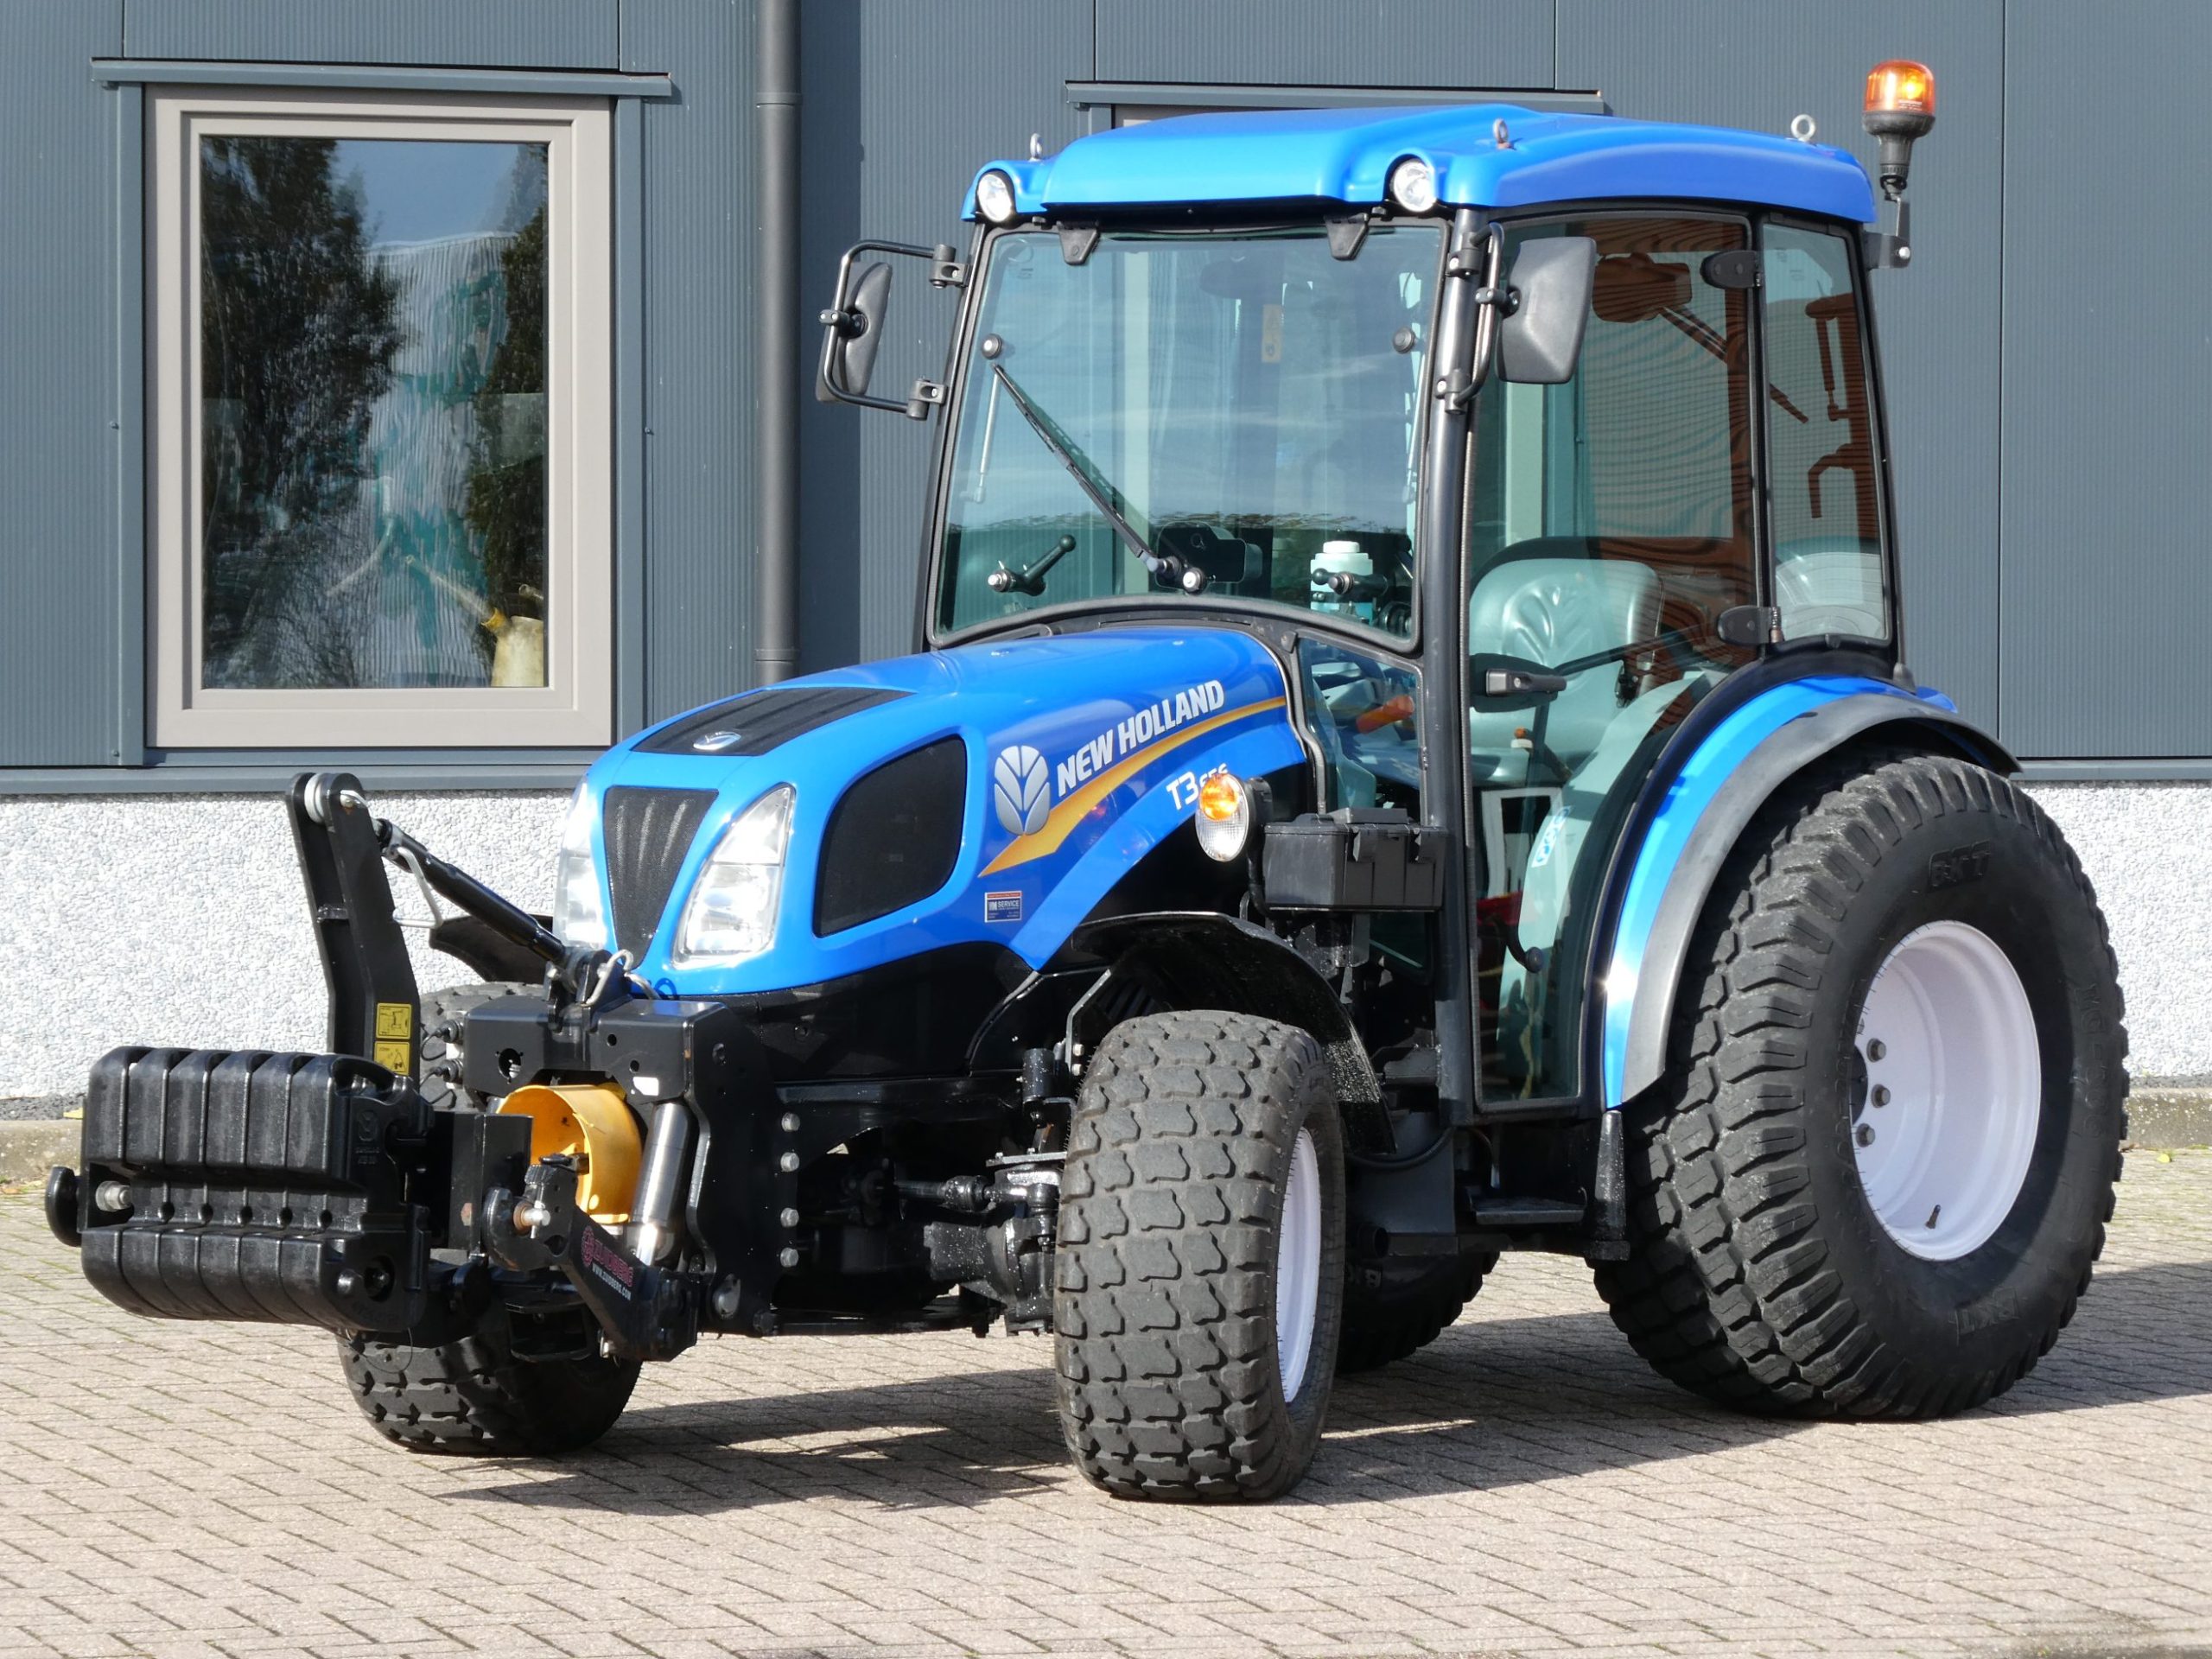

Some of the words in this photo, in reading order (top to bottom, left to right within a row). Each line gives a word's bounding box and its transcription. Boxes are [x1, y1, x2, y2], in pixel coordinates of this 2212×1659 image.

[1056, 729, 1114, 798] NEW
[1117, 679, 1225, 754] HOLLAND
[997, 899, 1020, 908] SERVICE
